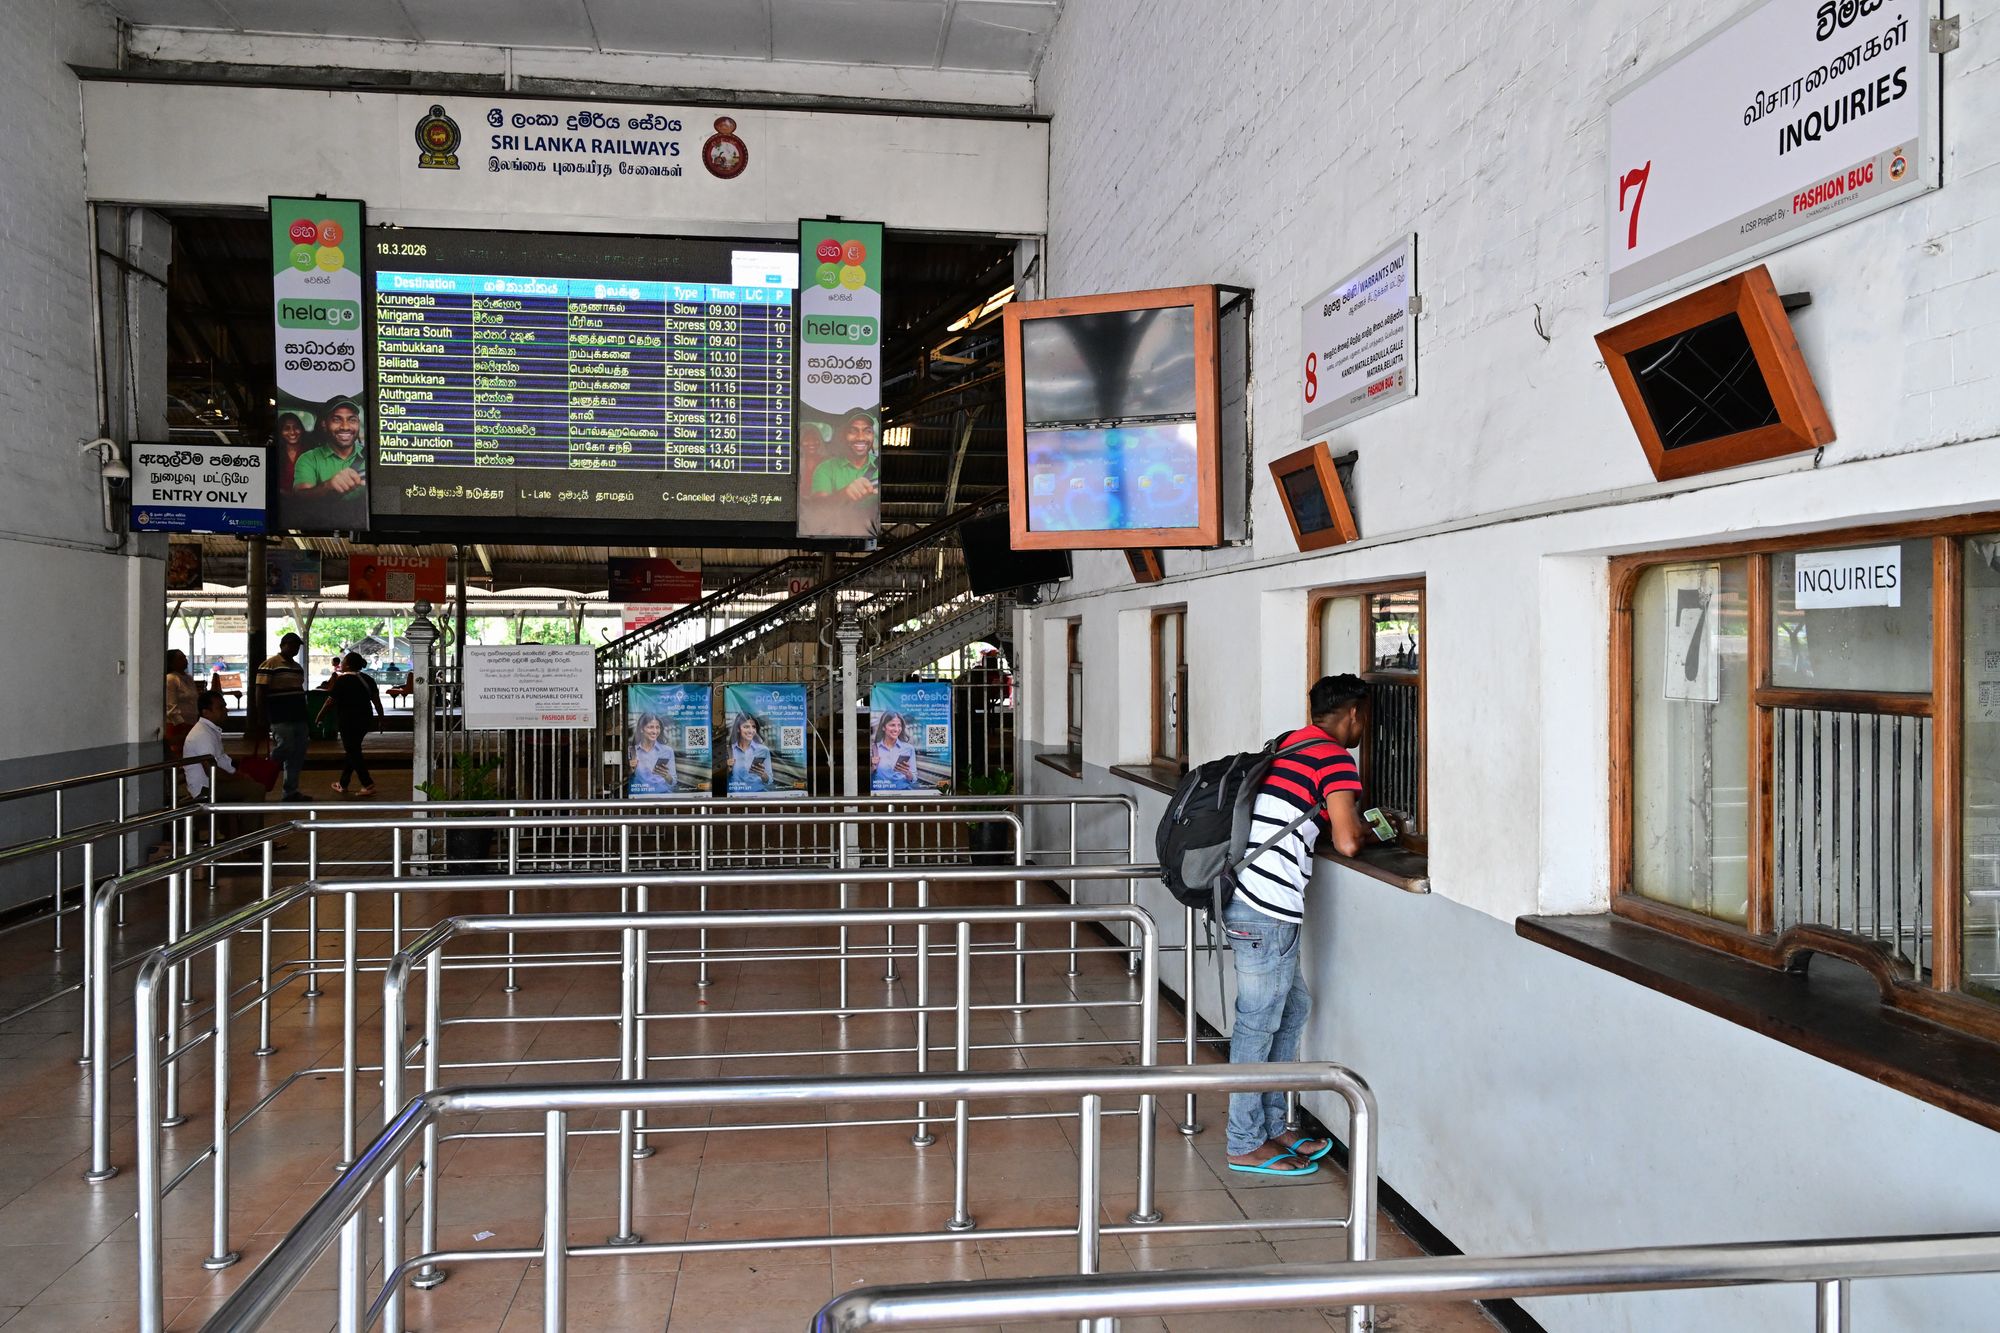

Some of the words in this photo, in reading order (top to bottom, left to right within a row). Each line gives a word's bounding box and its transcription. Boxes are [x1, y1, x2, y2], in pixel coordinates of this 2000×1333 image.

[1743, 14, 1909, 126] விசாரணைகள்
[1779, 66, 1908, 156] INQUIRIES
[511, 113, 558, 127] ලංකා
[566, 111, 620, 131] දුම්රිය
[628, 112, 682, 132] සේවය
[491, 134, 518, 150] SRI
[524, 136, 586, 153] LANKA
[592, 139, 680, 157] RAILWAYS
[488, 156, 547, 173] இலங்கை
[553, 159, 613, 177] புகையிரத
[618, 163, 682, 177] சேவைகள்
[1793, 175, 1844, 214] FASHION
[1848, 162, 1873, 191] BUG
[1619, 160, 1651, 249] 7
[1806, 203, 1830, 219] CHANGING
[1830, 192, 1859, 210] LIFESTYLES
[1745, 220, 1757, 233] CSR
[1757, 213, 1778, 228] Project
[1778, 208, 1786, 220] By
[376, 243, 427, 256] 18.3.2026
[1389, 254, 1405, 273] ONLY
[394, 276, 456, 289] Destination
[673, 287, 698, 301] Type
[711, 288, 736, 299] Time
[745, 289, 763, 300] L/C
[776, 290, 784, 299] P
[377, 293, 435, 307] Kurunegala
[673, 303, 698, 314] Slow
[709, 304, 737, 316] 09.00
[775, 307, 783, 318] 2
[282, 304, 354, 326] helago
[378, 310, 424, 322] Mirigama
[378, 325, 419, 337] Kalutara
[423, 327, 452, 338] South
[666, 319, 705, 333] Express
[709, 320, 737, 331] 09.30
[774, 322, 786, 333] 10
[807, 319, 873, 340] helago
[673, 335, 698, 346] Slow
[709, 335, 737, 347] 09.40
[775, 338, 783, 348] 5
[284, 340, 355, 356] සාධාරණ
[378, 341, 444, 353] Rambukkana
[673, 350, 698, 361] Slow
[709, 351, 737, 362] 10.10
[775, 353, 783, 364] 2
[284, 357, 356, 372] ගමනකට
[378, 357, 419, 368] Belliatta
[807, 355, 872, 370] සාධාරණ
[666, 365, 705, 379] Express
[709, 367, 737, 377] 10.30
[775, 369, 783, 379] 5
[1304, 352, 1317, 403] 8
[379, 373, 445, 384] Rambukkana
[807, 372, 872, 386] ගමනකට
[673, 381, 698, 392] Slow
[709, 382, 737, 393] 11.15
[775, 384, 783, 394] 2
[1367, 379, 1385, 397] FASHION
[1385, 375, 1394, 390] BUG
[379, 388, 433, 403] Aluthgama
[673, 396, 698, 408] Slow
[709, 398, 737, 408] 11.16
[775, 399, 783, 409] 5
[380, 404, 406, 415] Galle
[570, 409, 594, 420] காலி
[666, 411, 705, 425] Express
[709, 413, 737, 424] 12.16
[775, 414, 783, 425] 5
[380, 420, 444, 434] Polgahawela
[673, 427, 698, 438] Slow
[709, 428, 737, 439] 12.50
[775, 430, 783, 440] 2
[380, 435, 408, 447] Maho
[411, 437, 453, 448] Junction
[571, 441, 605, 452] மாகோ
[608, 441, 632, 454] சந்தி
[666, 442, 705, 456] Express
[709, 444, 737, 454] 13.45
[775, 445, 783, 455] 4
[138, 451, 203, 468] ඇතුල්වීම
[209, 454, 260, 468] පමණයි
[380, 451, 434, 464] Aluthgama
[673, 458, 698, 469] Slow
[709, 459, 737, 469] 14.01
[775, 460, 783, 470] 5
[151, 472, 195, 485] நுழைவு
[203, 471, 249, 486] மட்டுமே
[152, 489, 203, 502] ENTRY
[206, 491, 248, 503] ONLY
[521, 489, 526, 498] L
[534, 490, 552, 499] Late
[662, 491, 669, 501] C
[676, 492, 715, 502] Cancelled
[377, 556, 429, 568] HUTCH
[1797, 564, 1897, 594] INQUIRIES
[790, 579, 809, 594] 04
[1676, 588, 1712, 682] 7
